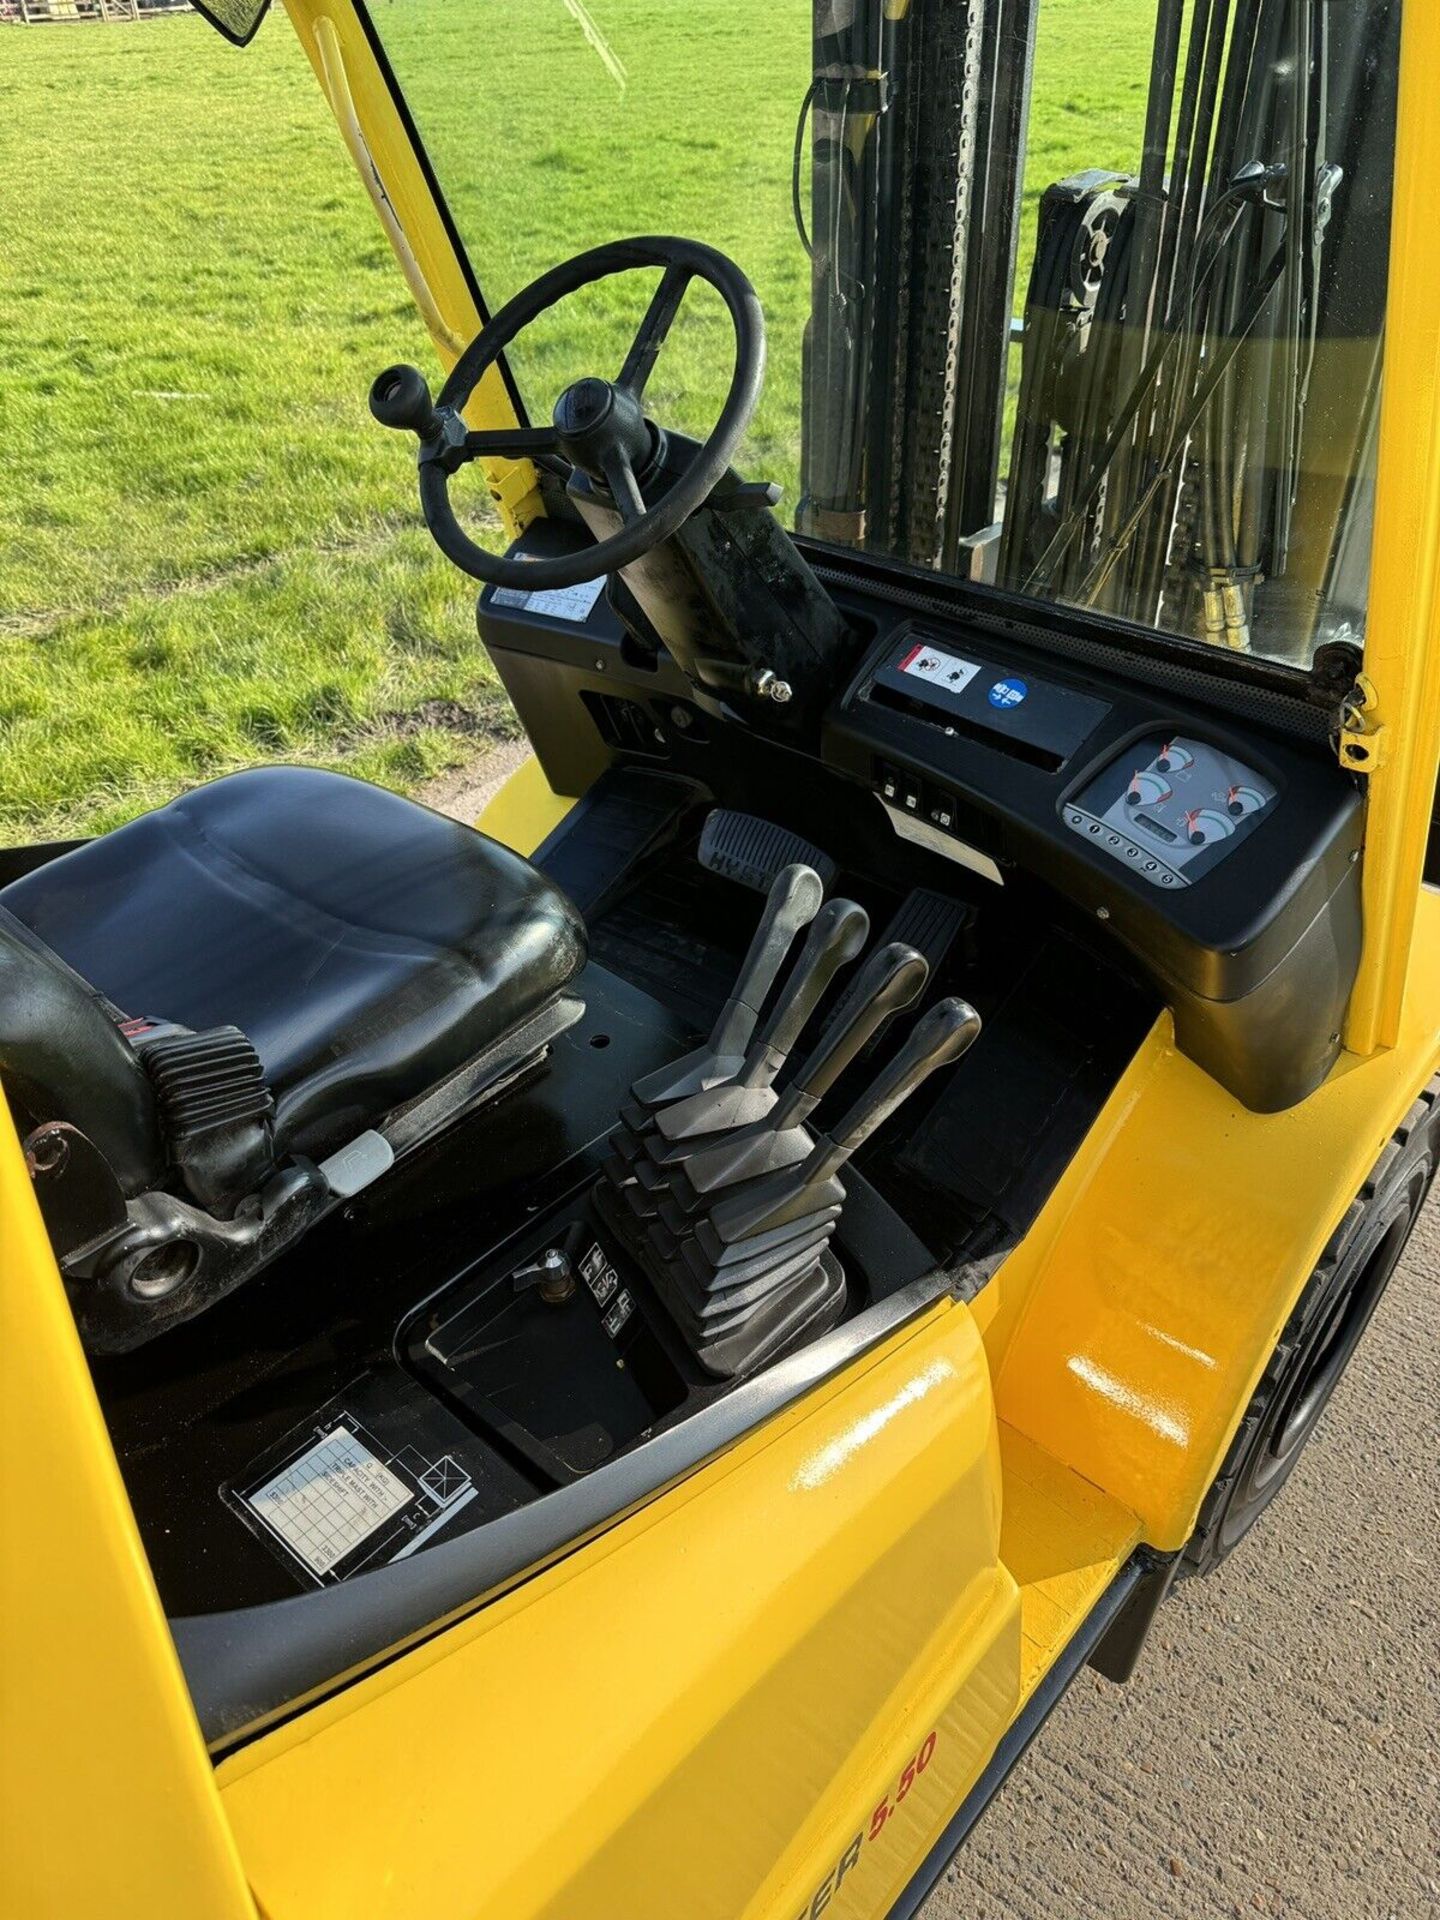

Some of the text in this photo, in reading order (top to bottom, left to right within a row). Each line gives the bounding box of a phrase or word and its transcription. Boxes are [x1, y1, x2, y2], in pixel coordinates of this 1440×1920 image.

[331, 1462, 379, 1509] TRIPLE MAST WITH
[344, 1458, 385, 1496] CAPACITY WITH
[868, 1731, 937, 1842] 5.50
